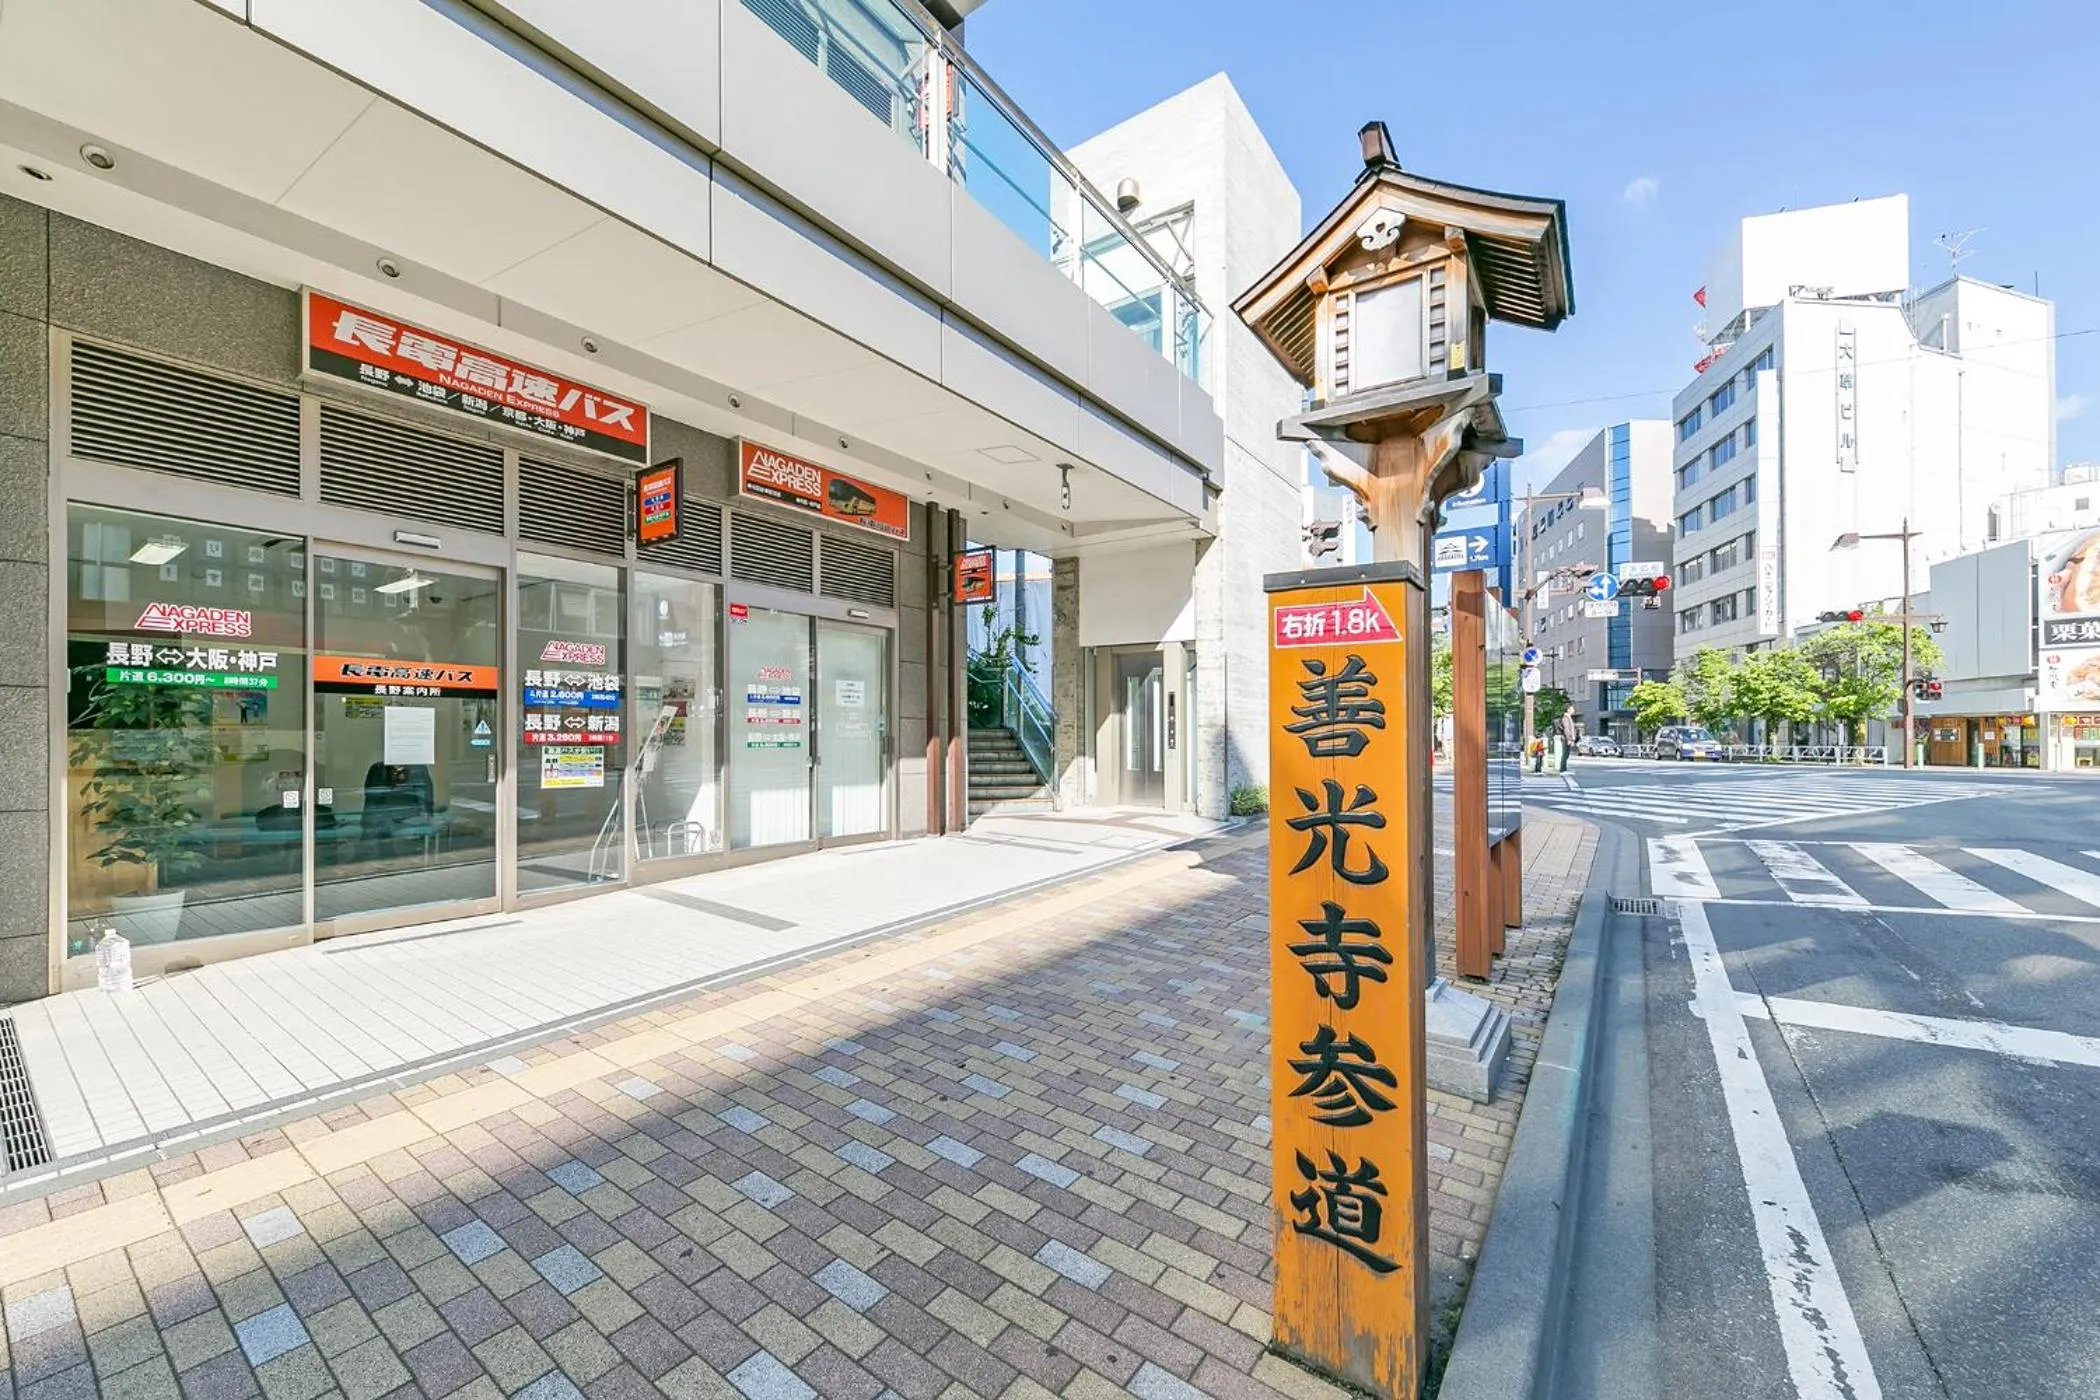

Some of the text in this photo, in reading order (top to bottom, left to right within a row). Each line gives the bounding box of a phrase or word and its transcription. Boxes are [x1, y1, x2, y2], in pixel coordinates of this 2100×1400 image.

[332, 310, 636, 432] 長電高速バス
[359, 363, 389, 384] 長野
[438, 374, 503, 402] NAGADEN
[506, 390, 560, 418] EXPRESS
[752, 450, 821, 484] NAGADEN
[747, 463, 822, 498] EXPRESS
[145, 602, 251, 624] NAGADEN
[1281, 611, 1326, 639] 右折
[134, 616, 252, 637] EXPRESS
[106, 642, 278, 672] 長野 大阪・神戸
[341, 663, 473, 683] 長電高速バス
[525, 670, 620, 691] 長野 池袋
[374, 685, 441, 697] 長野案内所
[525, 714, 620, 732] 長野 新潟
[1284, 655, 1402, 1275] 善光寺参道
